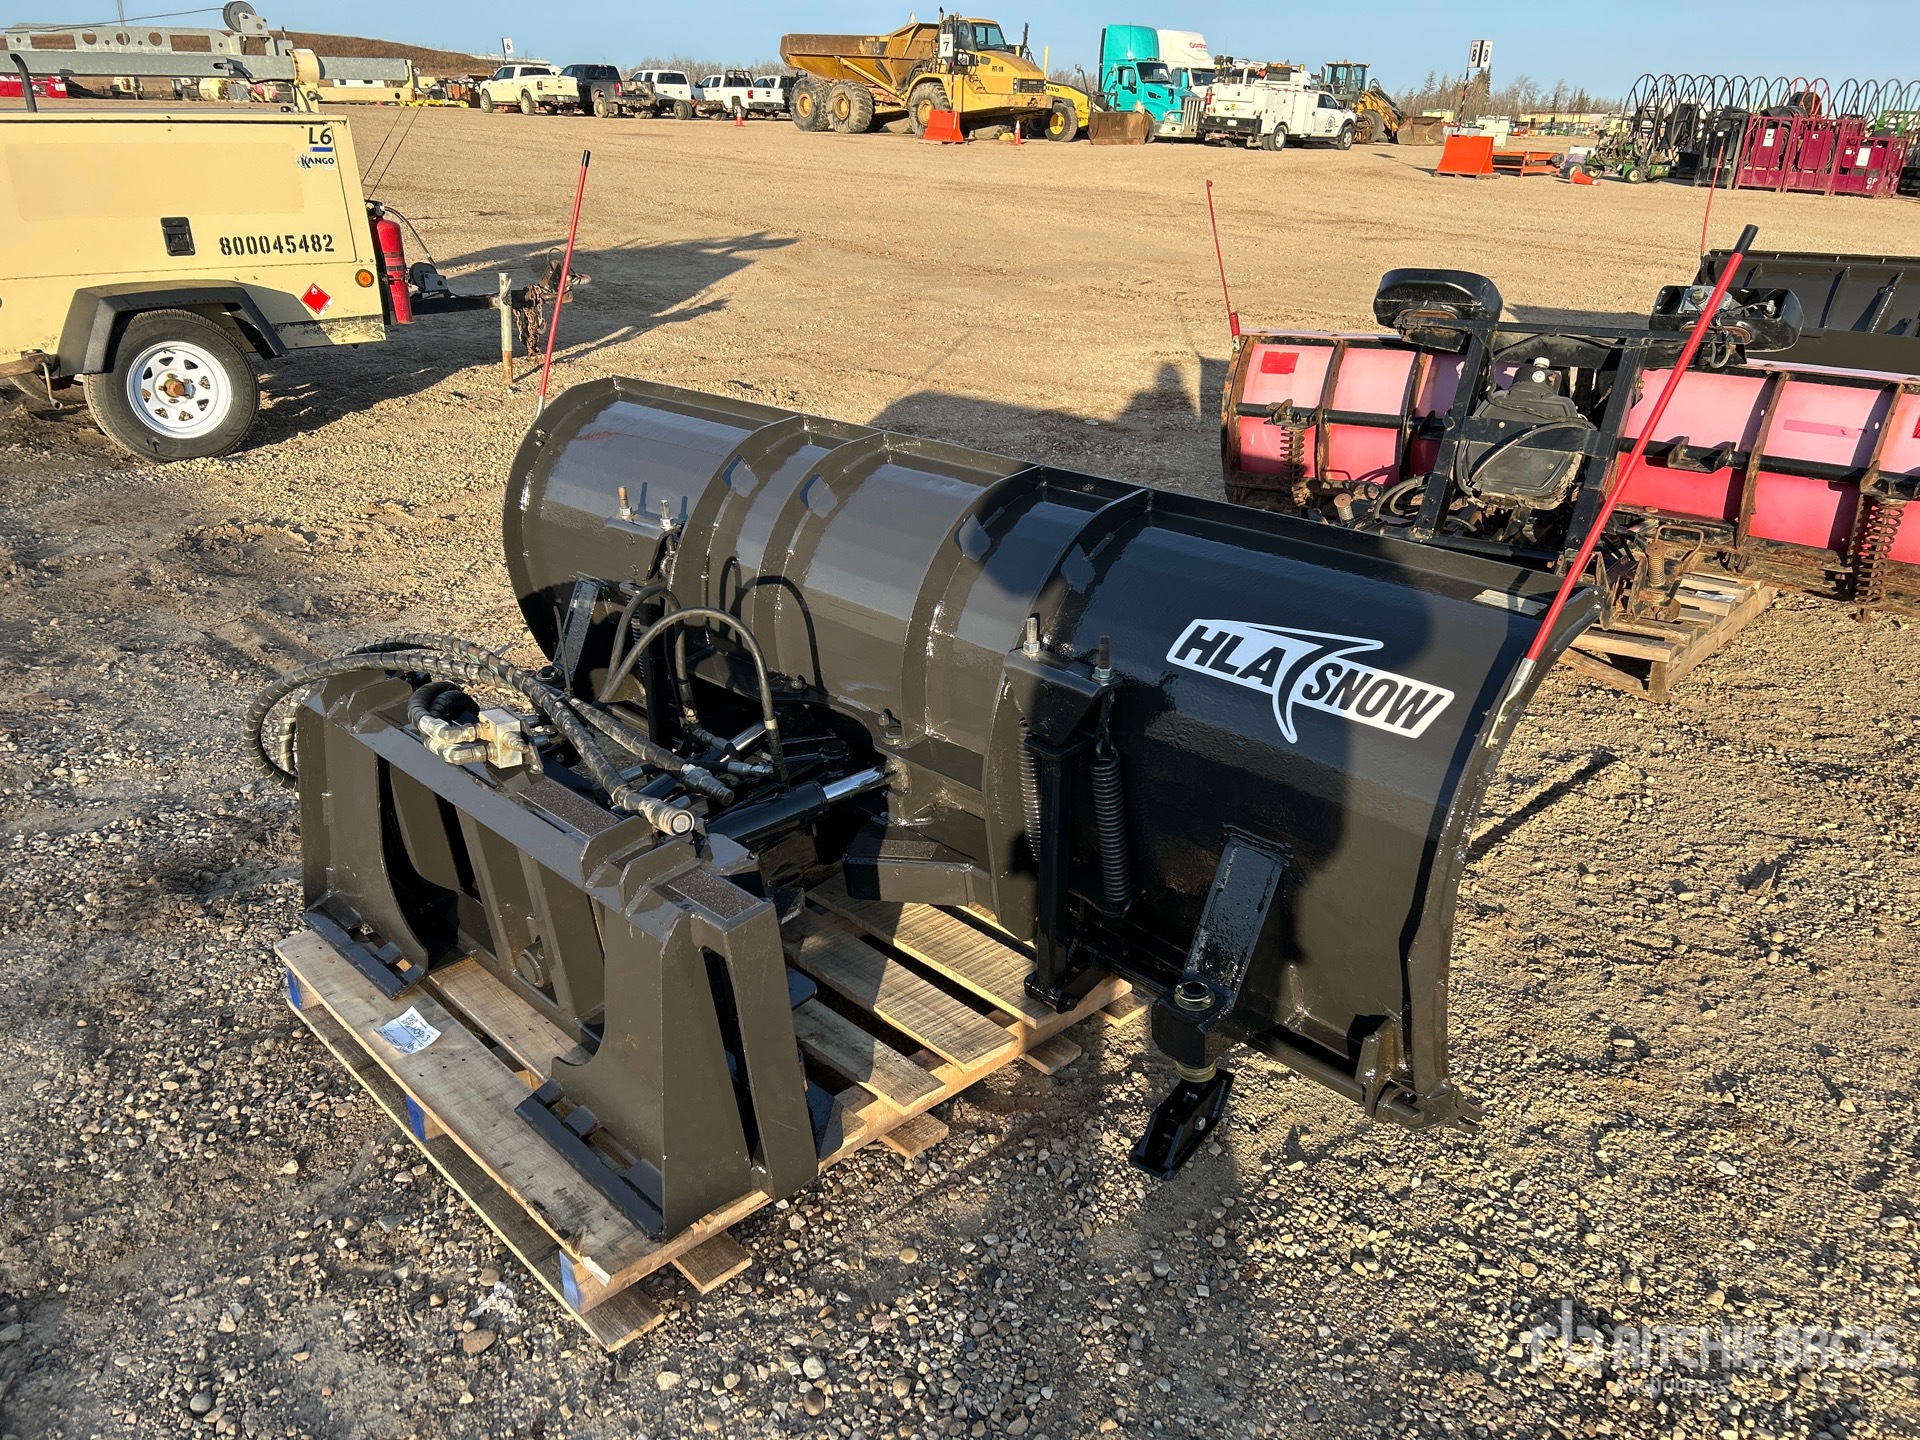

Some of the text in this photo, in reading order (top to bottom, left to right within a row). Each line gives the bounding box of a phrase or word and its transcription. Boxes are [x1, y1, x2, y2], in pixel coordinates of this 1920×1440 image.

[943, 41, 950, 52] 7
[1472, 49, 1477, 62] 8
[1484, 49, 1489, 62] 8
[309, 127, 332, 145] L6
[1867, 177, 1878, 185] GP
[219, 233, 335, 256] 800045482
[1174, 625, 1445, 730] HLA SNOW
